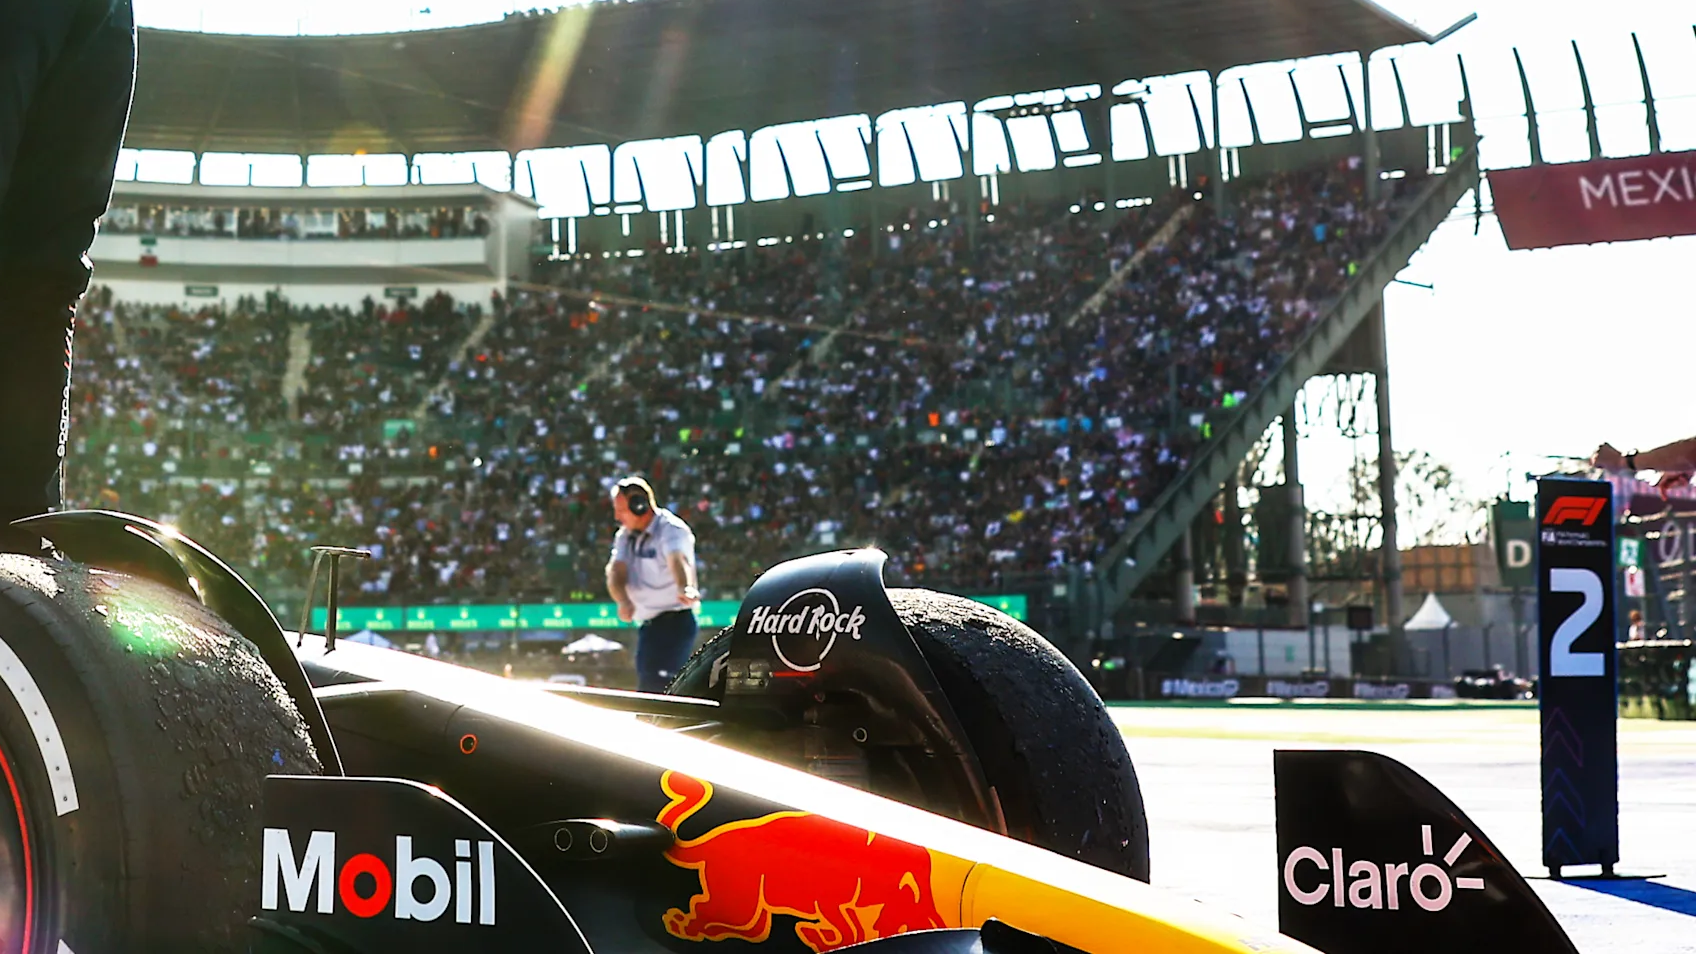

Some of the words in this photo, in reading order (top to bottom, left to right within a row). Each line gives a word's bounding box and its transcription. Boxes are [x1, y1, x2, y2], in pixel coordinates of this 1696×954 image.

[1579, 167, 1696, 210] MEXI
[1550, 568, 1605, 677] 2
[261, 827, 496, 926] Mobil
[1284, 846, 1453, 912] Claro
